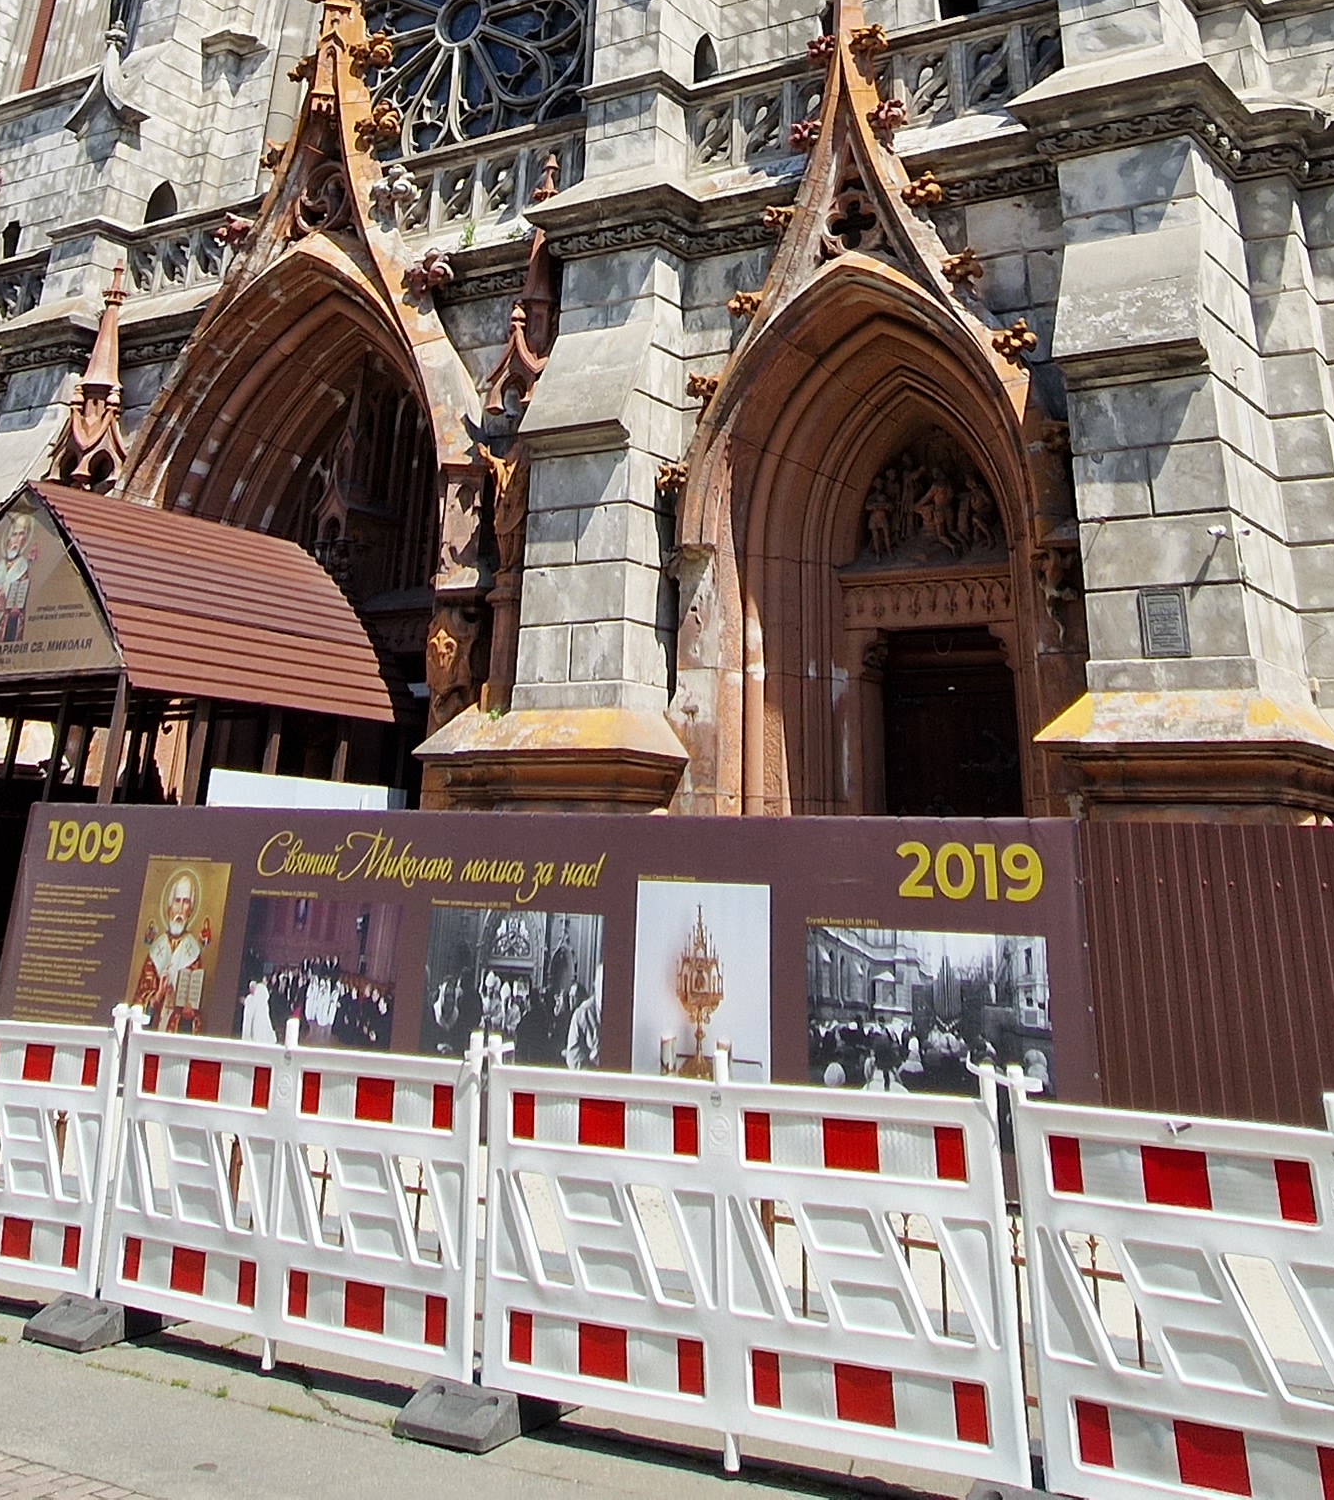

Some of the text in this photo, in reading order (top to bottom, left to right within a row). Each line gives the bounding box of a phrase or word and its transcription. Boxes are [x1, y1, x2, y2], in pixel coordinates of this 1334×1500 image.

[47, 638, 93, 650] МИКОЛАЯ
[46, 820, 124, 864] 1909
[257, 827, 607, 903] Святий Миколаю, молись за нас!
[895, 841, 1044, 902] 2019
